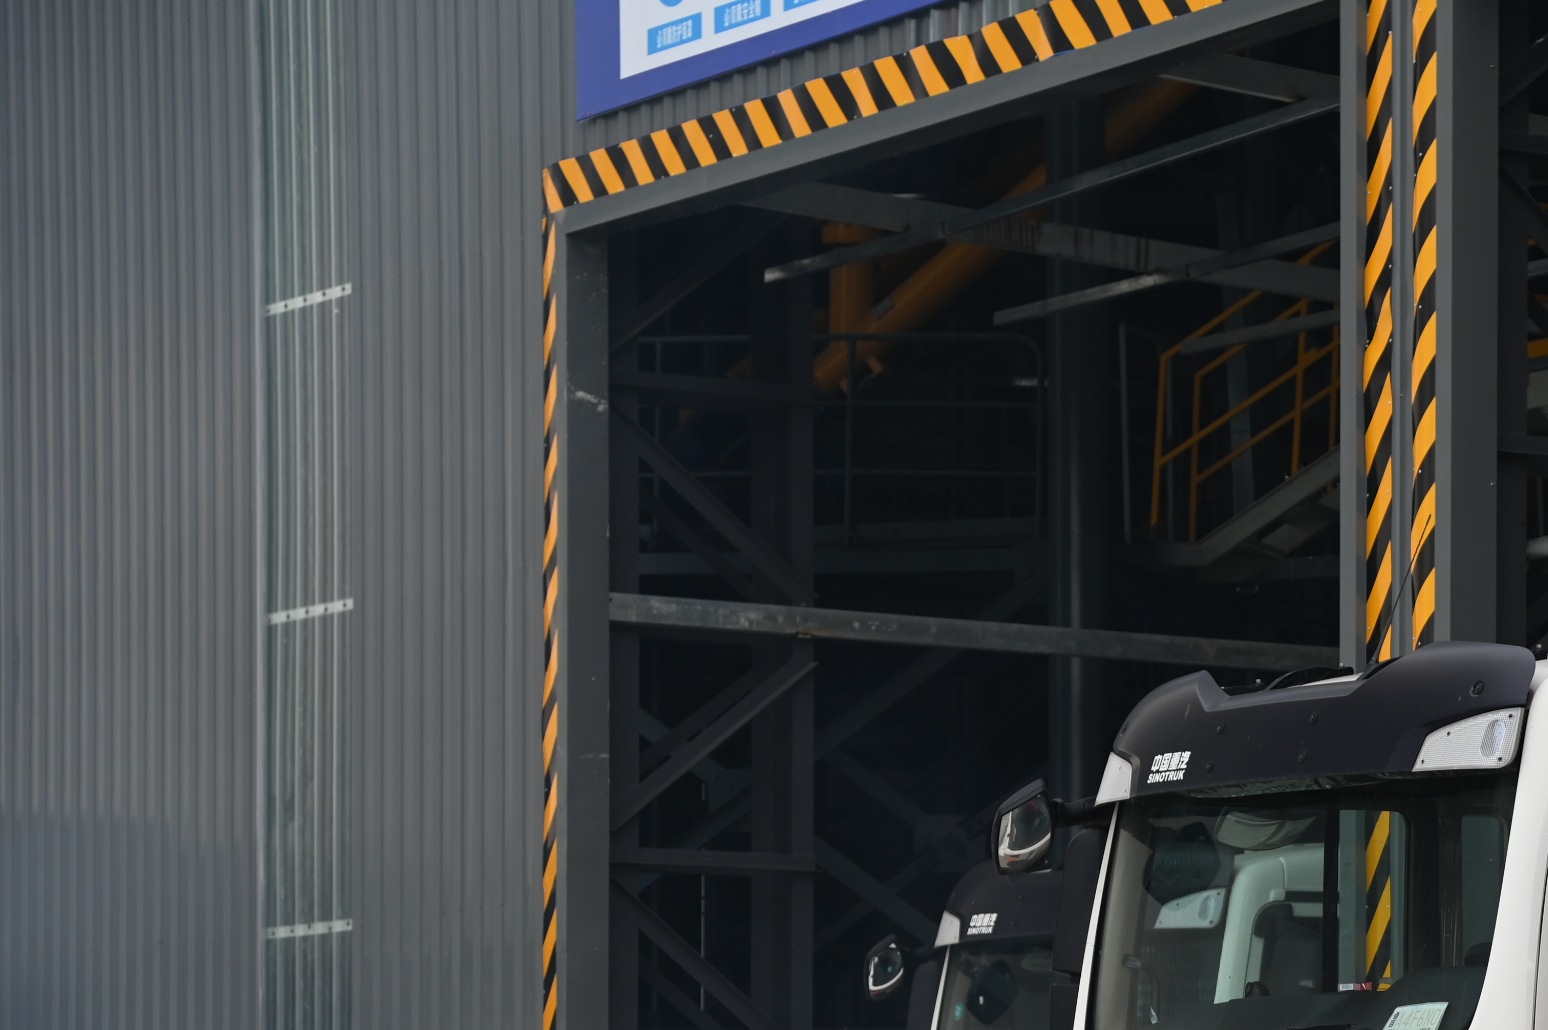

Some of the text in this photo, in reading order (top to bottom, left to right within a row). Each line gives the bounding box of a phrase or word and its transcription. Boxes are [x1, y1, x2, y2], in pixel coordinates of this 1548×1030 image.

[1151, 751, 1191, 772] 中国重汽
[1147, 769, 1186, 784] SINOTRUK
[969, 913, 998, 927] 中国重汽
[967, 925, 994, 935] SINOTRUK
